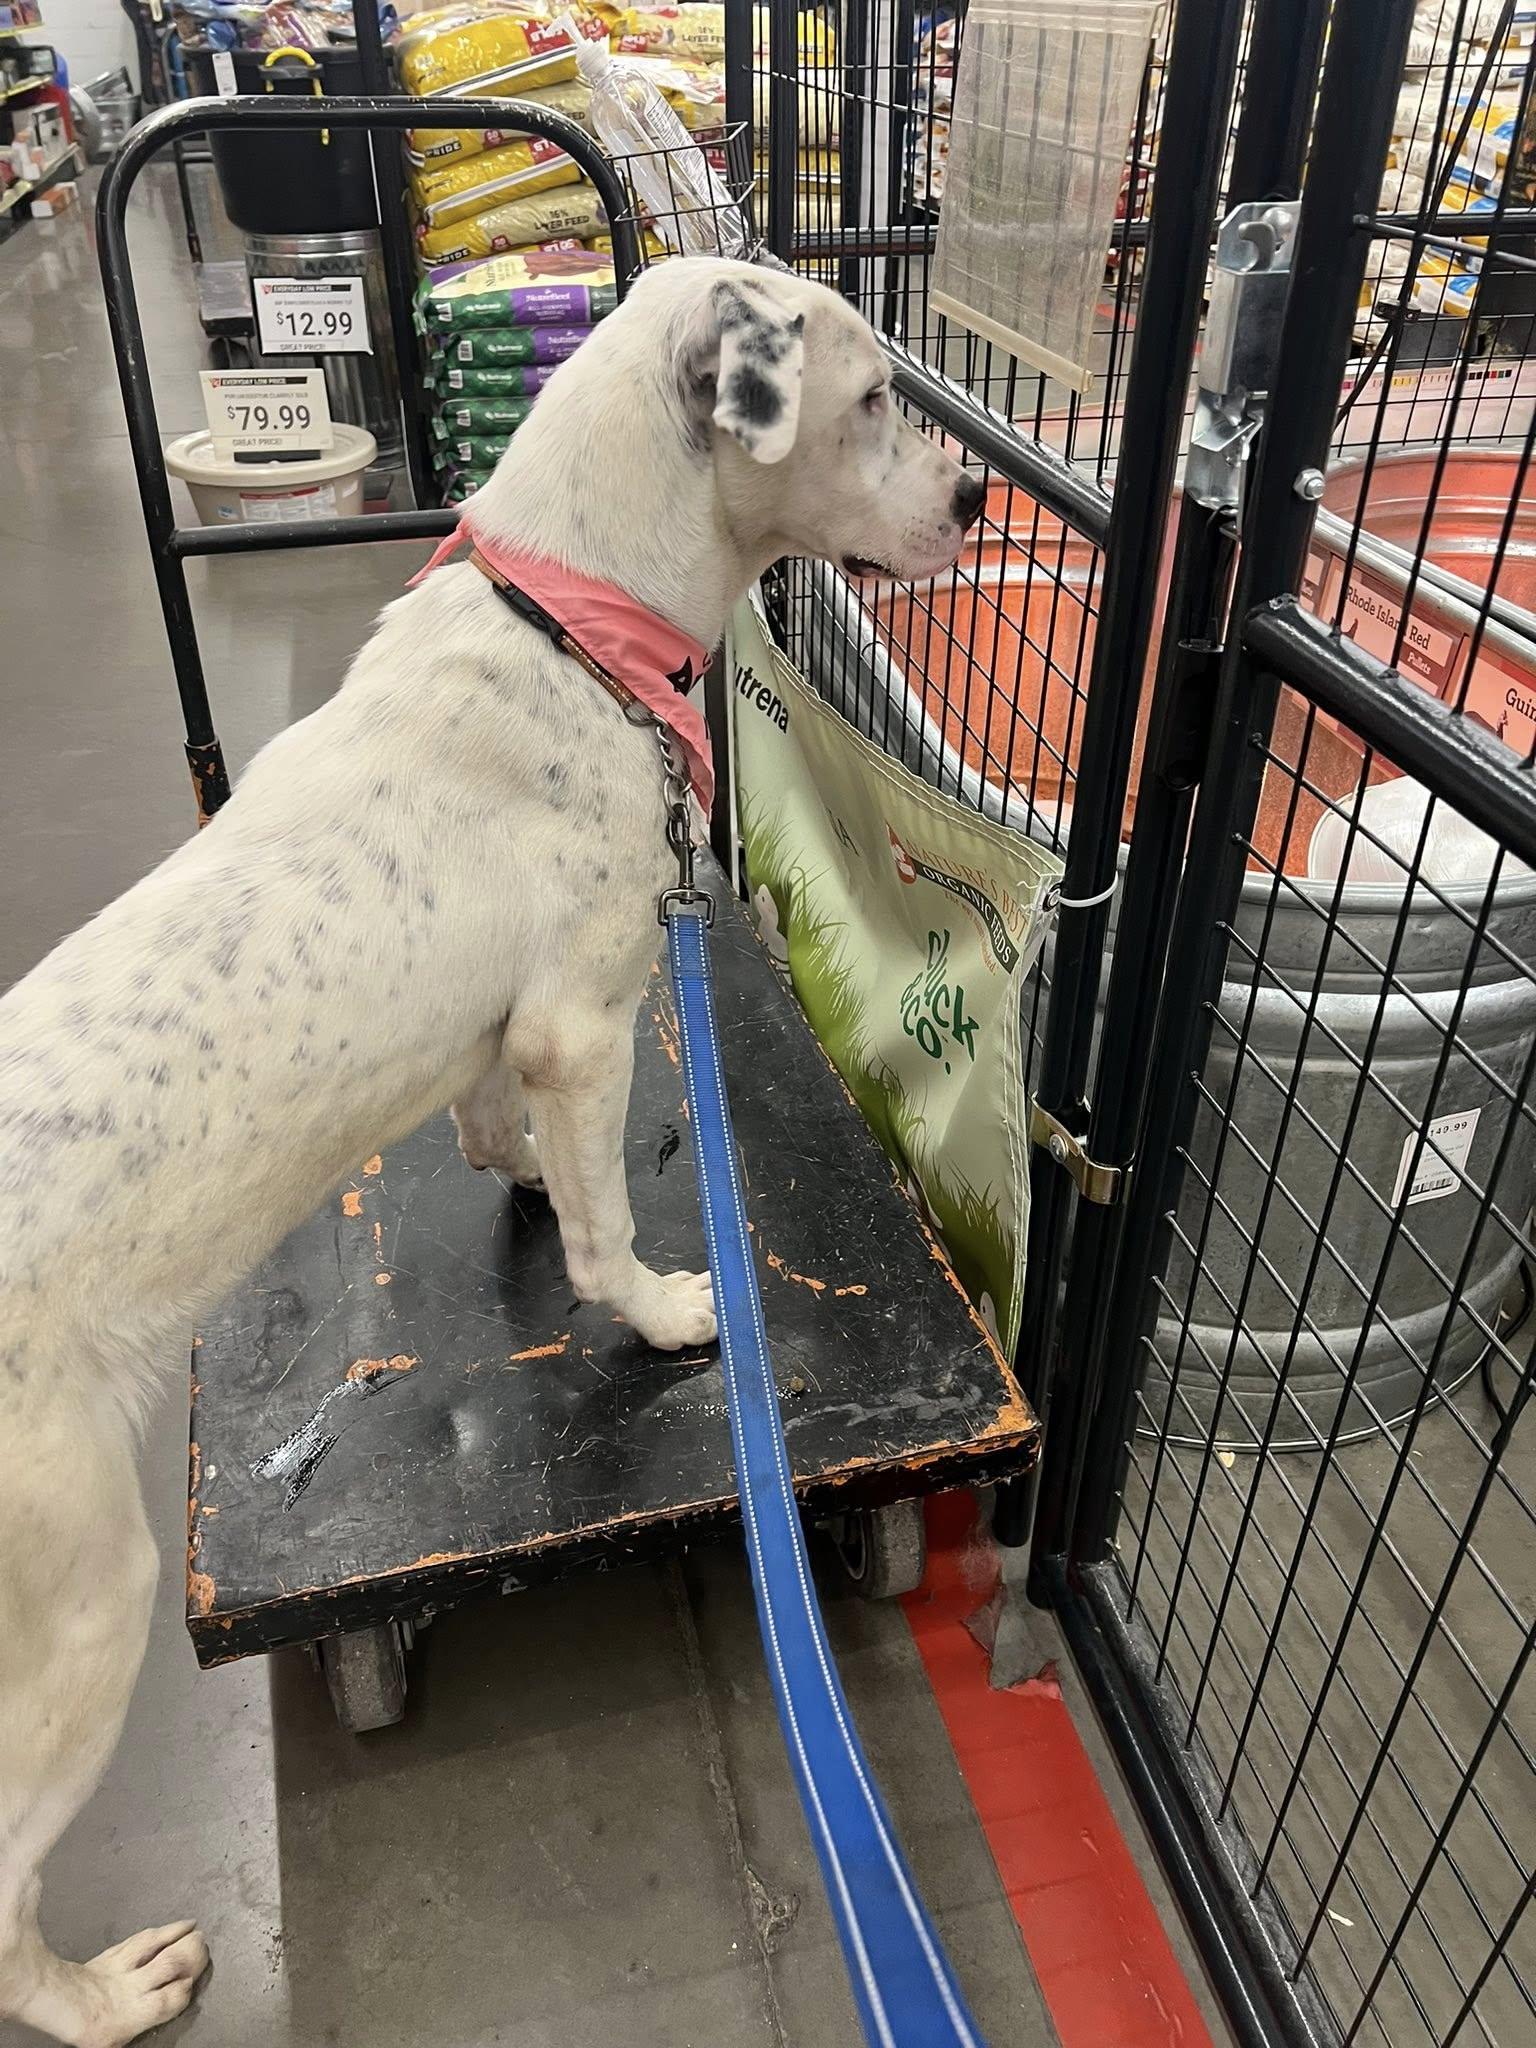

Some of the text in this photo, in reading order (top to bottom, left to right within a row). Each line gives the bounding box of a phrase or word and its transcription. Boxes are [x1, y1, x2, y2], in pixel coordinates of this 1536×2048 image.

[565, 215, 589, 226] FEED
[316, 284, 332, 292] PRICE
[276, 311, 352, 336] $12.99
[280, 344, 302, 352] GREAT
[268, 377, 286, 385] PRICE
[227, 405, 311, 430] $79.99
[232, 439, 256, 447] GREAT
[1346, 586, 1431, 650] Rhode Islan Red
[1407, 652, 1431, 675] Pullets
[906, 839, 1029, 941] NATURE'S BEST
[922, 866, 1012, 963] ORGANIC FEEDS
